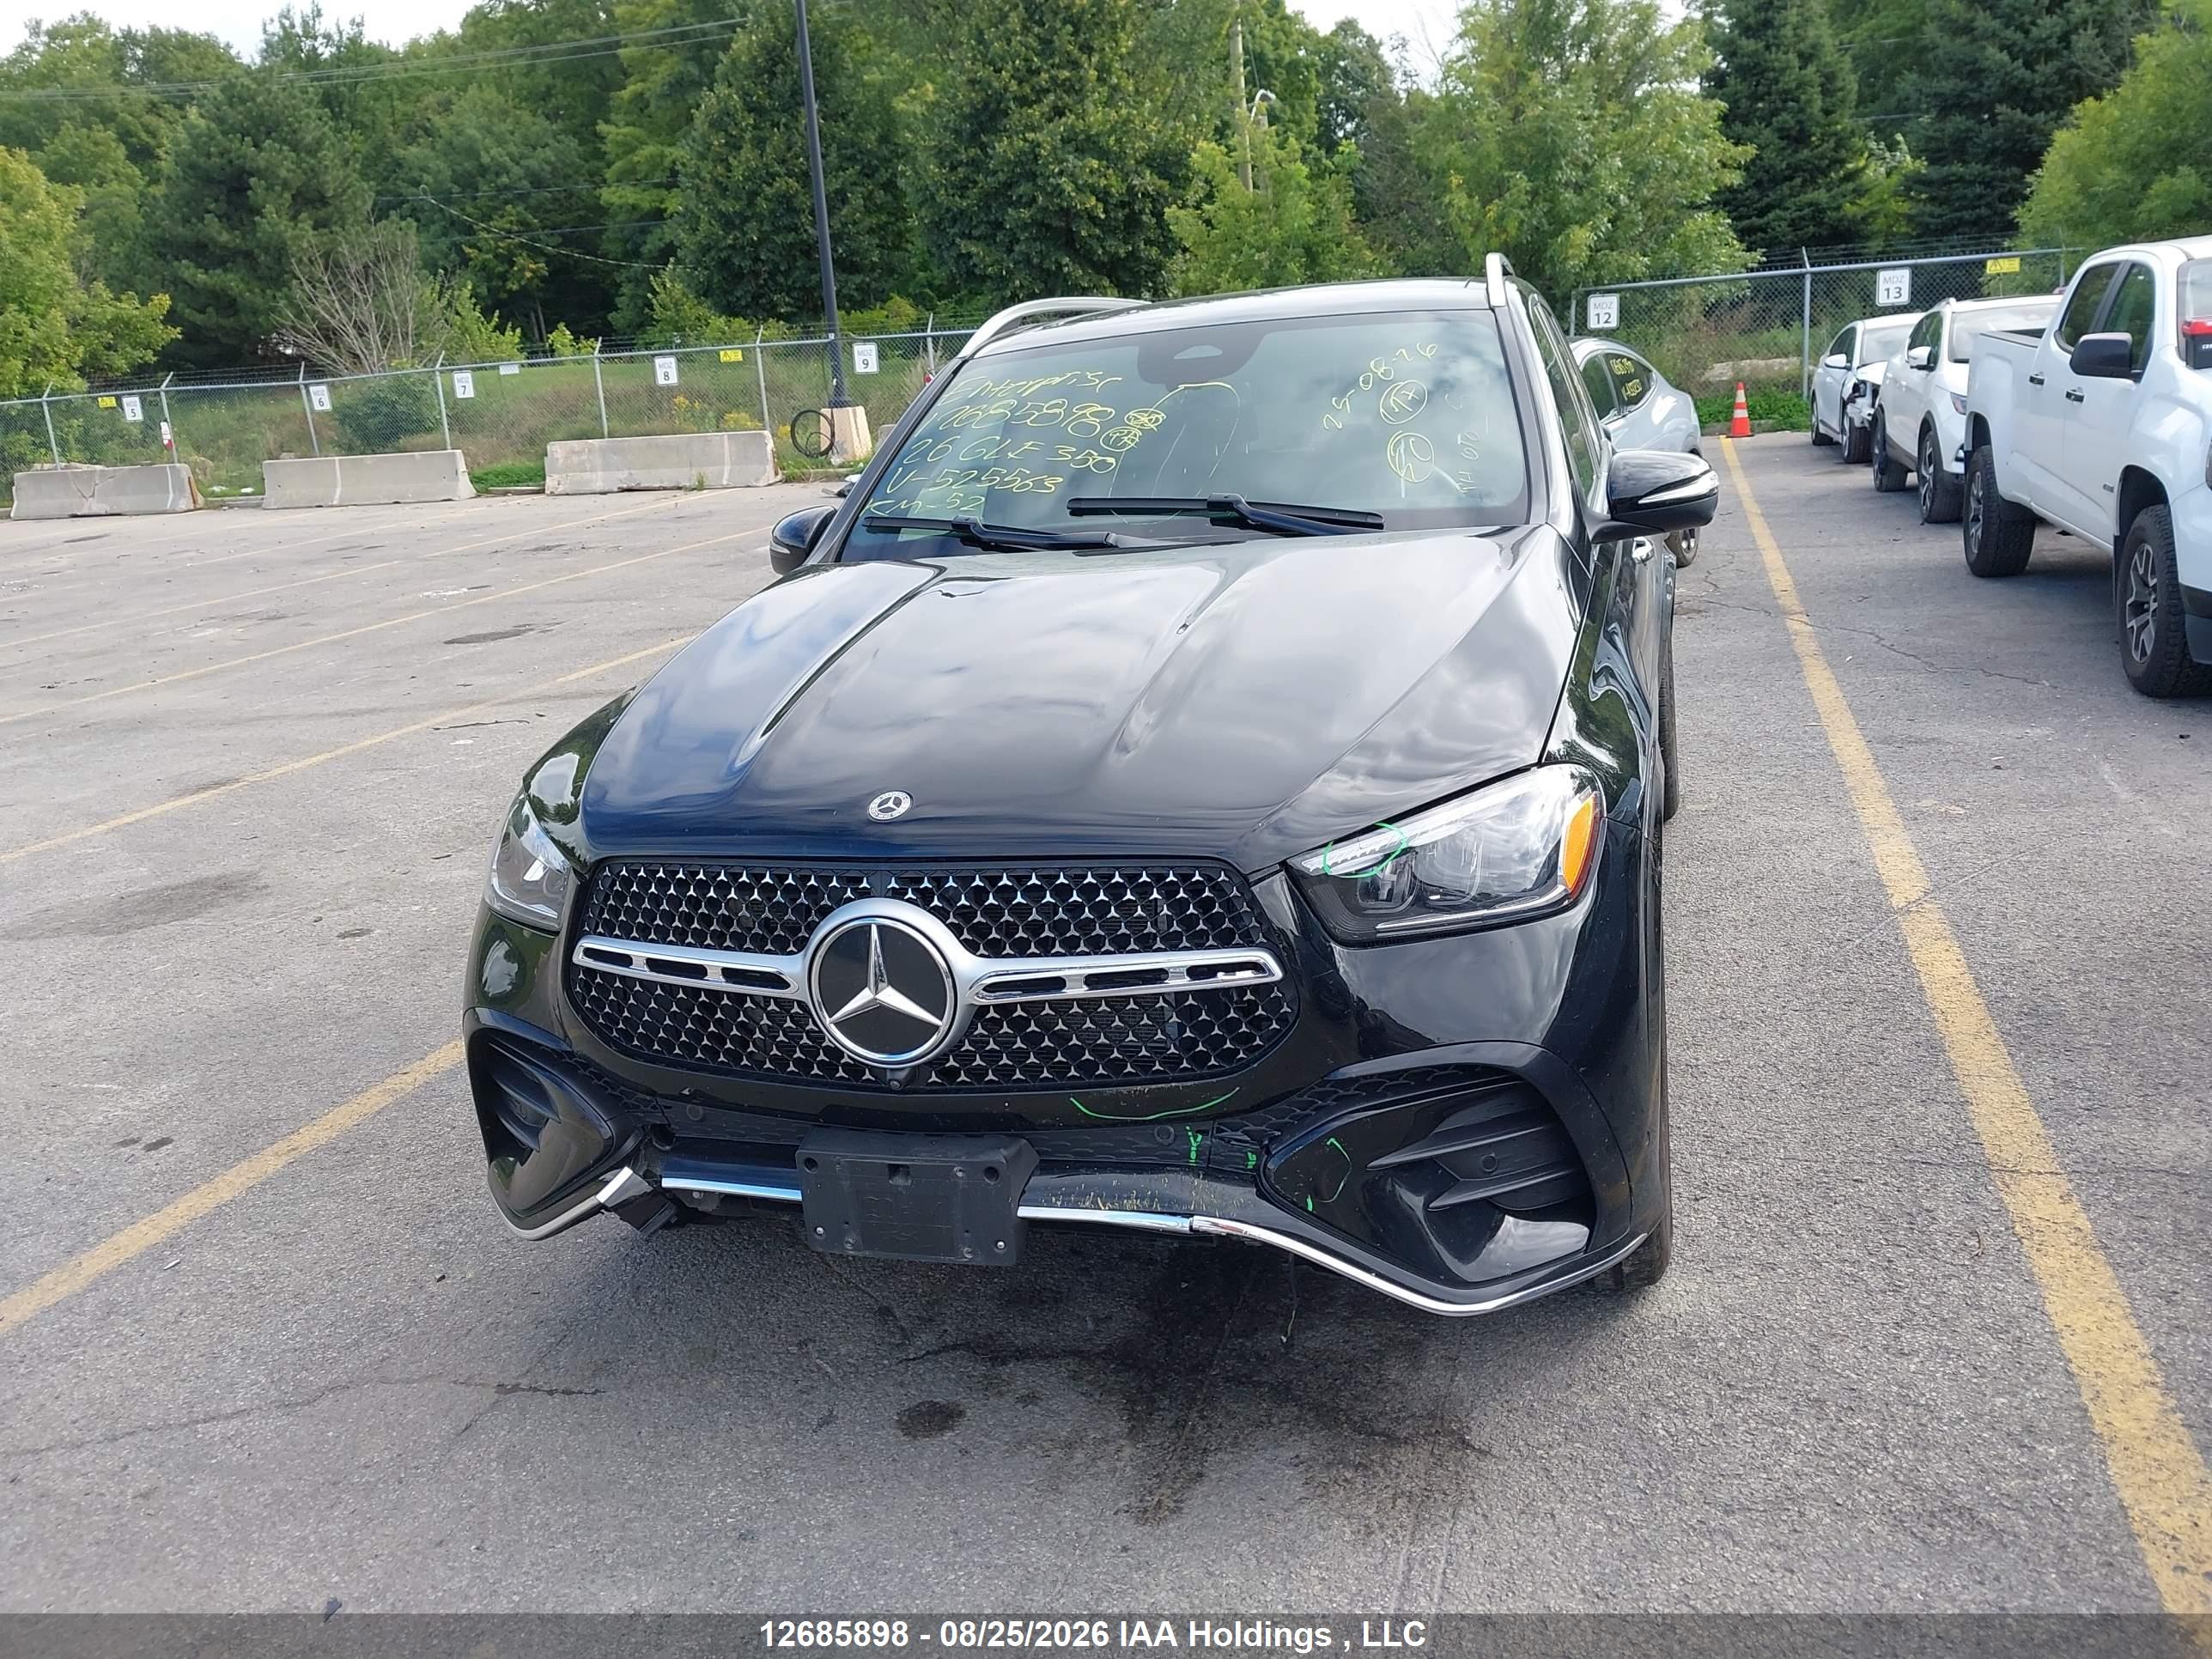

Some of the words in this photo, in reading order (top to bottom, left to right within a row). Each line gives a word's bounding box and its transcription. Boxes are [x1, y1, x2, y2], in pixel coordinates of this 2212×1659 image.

[1883, 275, 1905, 284] MDZ
[1884, 287, 1903, 300] 13
[1594, 301, 1613, 310] MDZ
[1595, 313, 1612, 325] 12
[861, 358, 869, 369] 9
[663, 372, 670, 381] 8
[460, 385, 467, 395] 7
[318, 398, 325, 408] 6
[131, 408, 137, 418] 5
[902, 436, 962, 465] 26
[1046, 445, 1116, 473] 350
